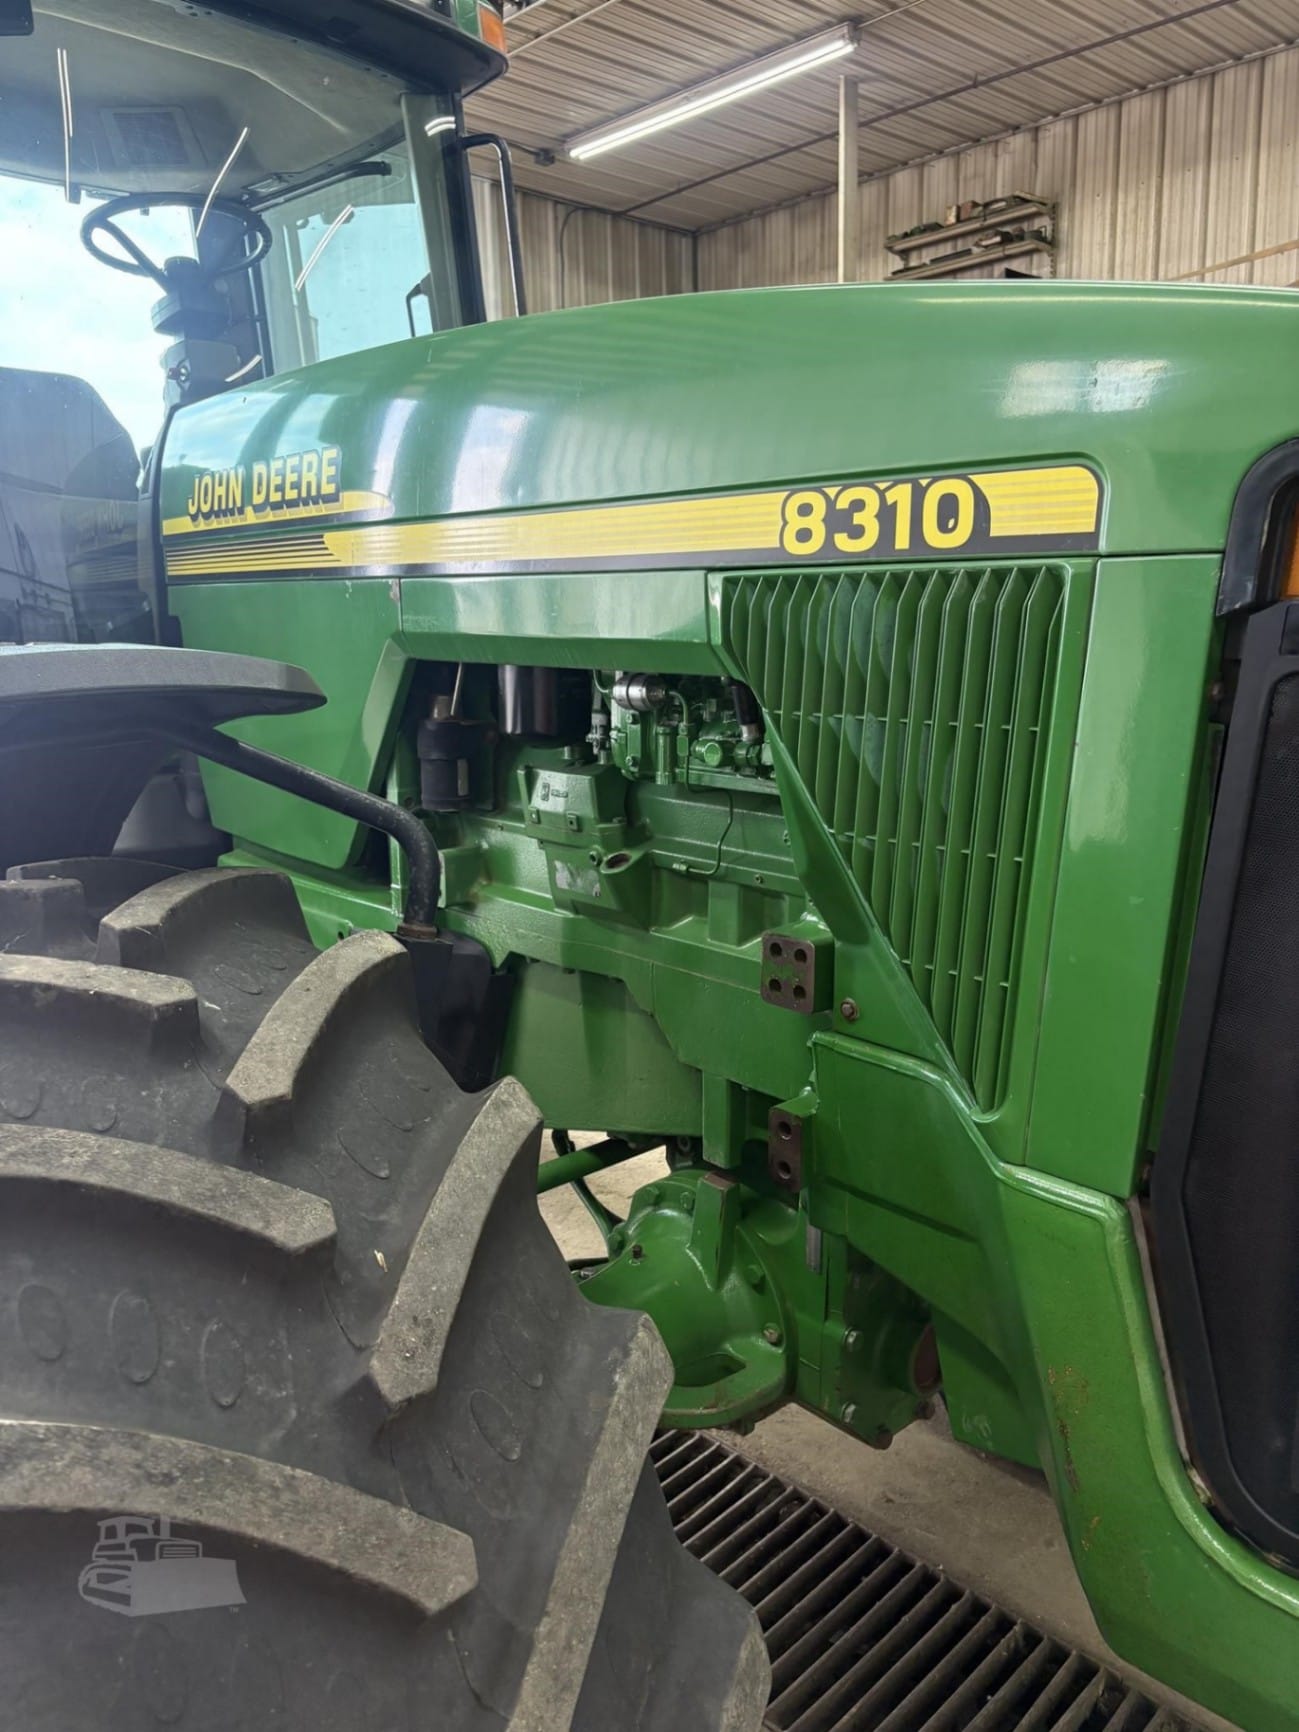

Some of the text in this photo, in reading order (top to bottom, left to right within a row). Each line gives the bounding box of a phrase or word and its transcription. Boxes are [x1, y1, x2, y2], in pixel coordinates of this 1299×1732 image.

[187, 467, 245, 517] JOHN
[252, 448, 338, 508] DEERE
[783, 478, 975, 556] 8310
